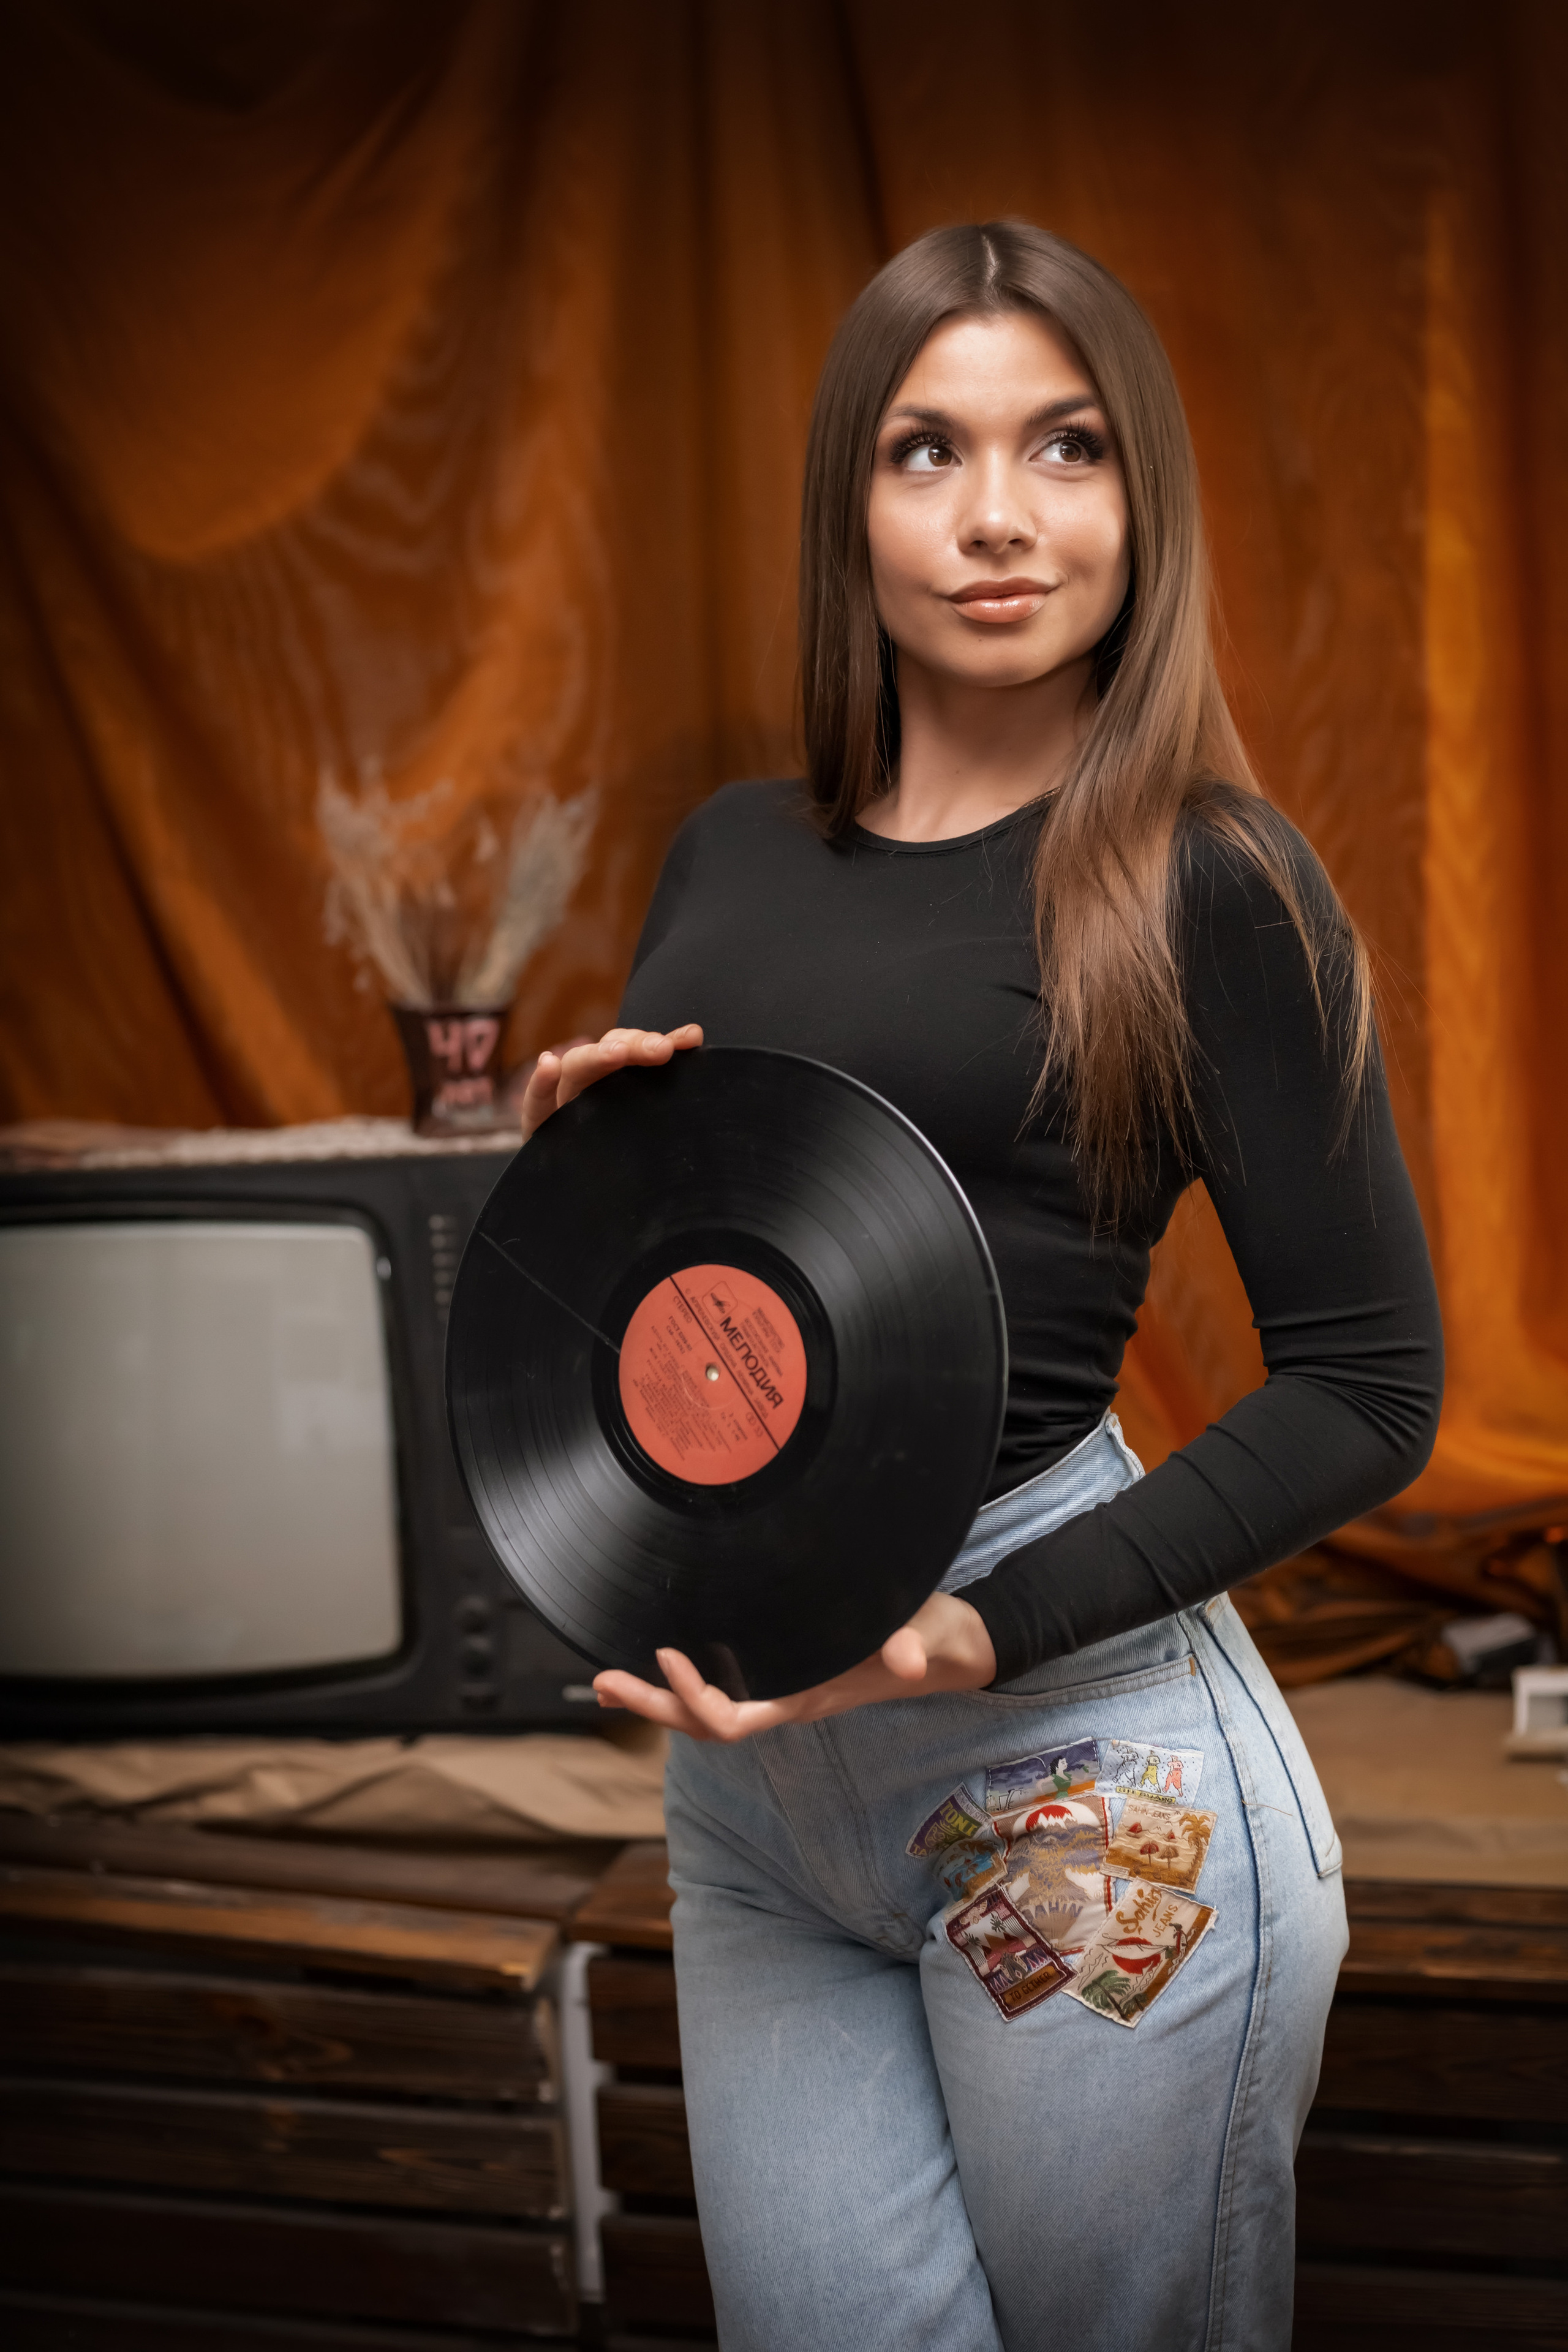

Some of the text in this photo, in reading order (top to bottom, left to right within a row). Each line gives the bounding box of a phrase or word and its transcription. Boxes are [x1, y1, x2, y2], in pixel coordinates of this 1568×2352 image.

[719, 1316, 784, 1410] МЕЛОДИЯ
[940, 1800, 978, 1836] TONI
[1152, 1904, 1178, 1938] JEANS
[1021, 1972, 1052, 1995] GETHER
